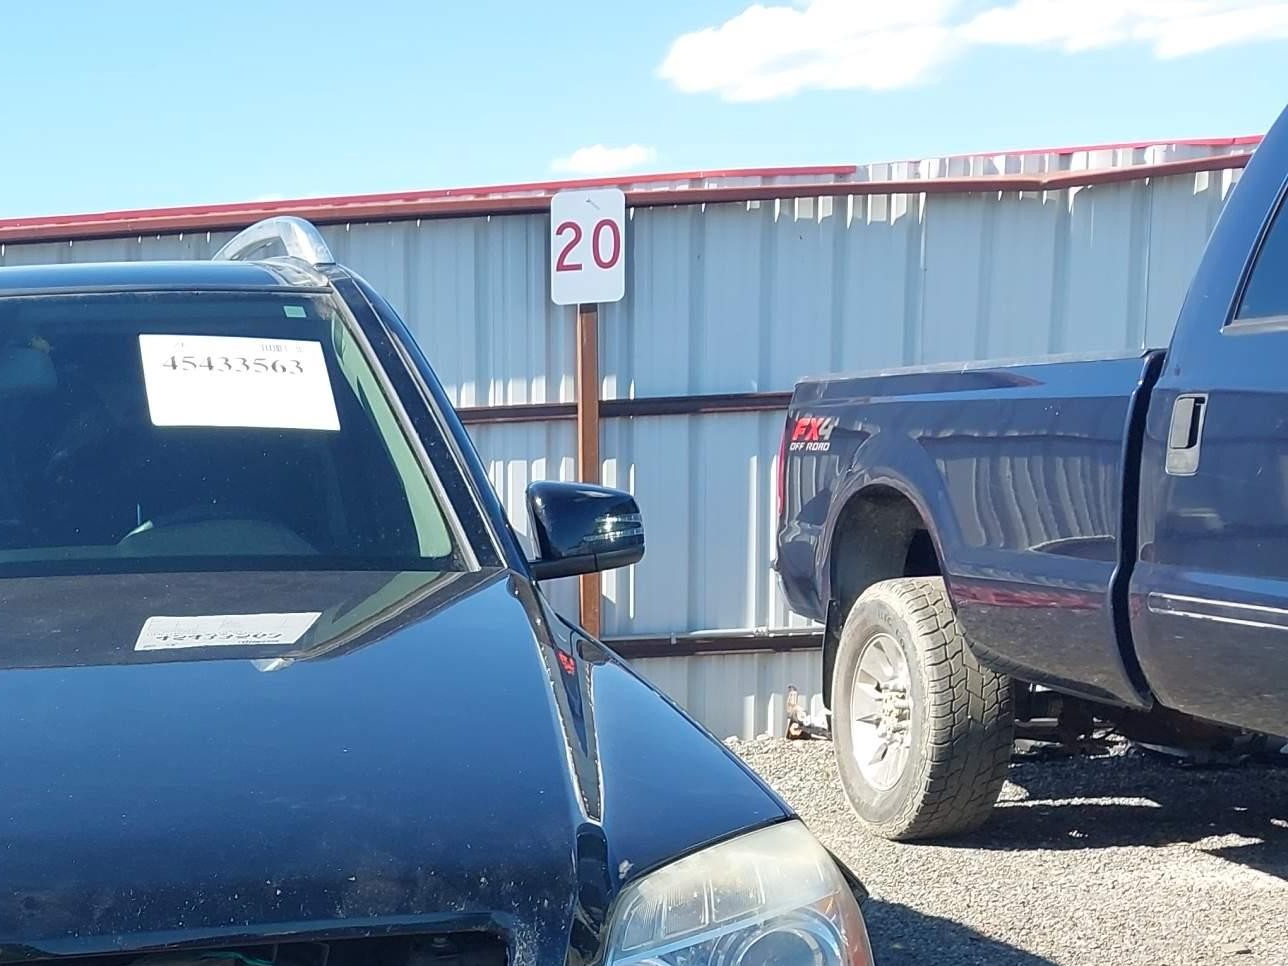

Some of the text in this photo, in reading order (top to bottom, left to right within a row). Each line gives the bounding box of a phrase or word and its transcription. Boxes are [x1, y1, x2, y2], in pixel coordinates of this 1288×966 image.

[555, 218, 621, 272] 20
[162, 355, 304, 375] 45433563
[792, 417, 834, 441] FX4
[789, 442, 831, 451] OFF ROAD
